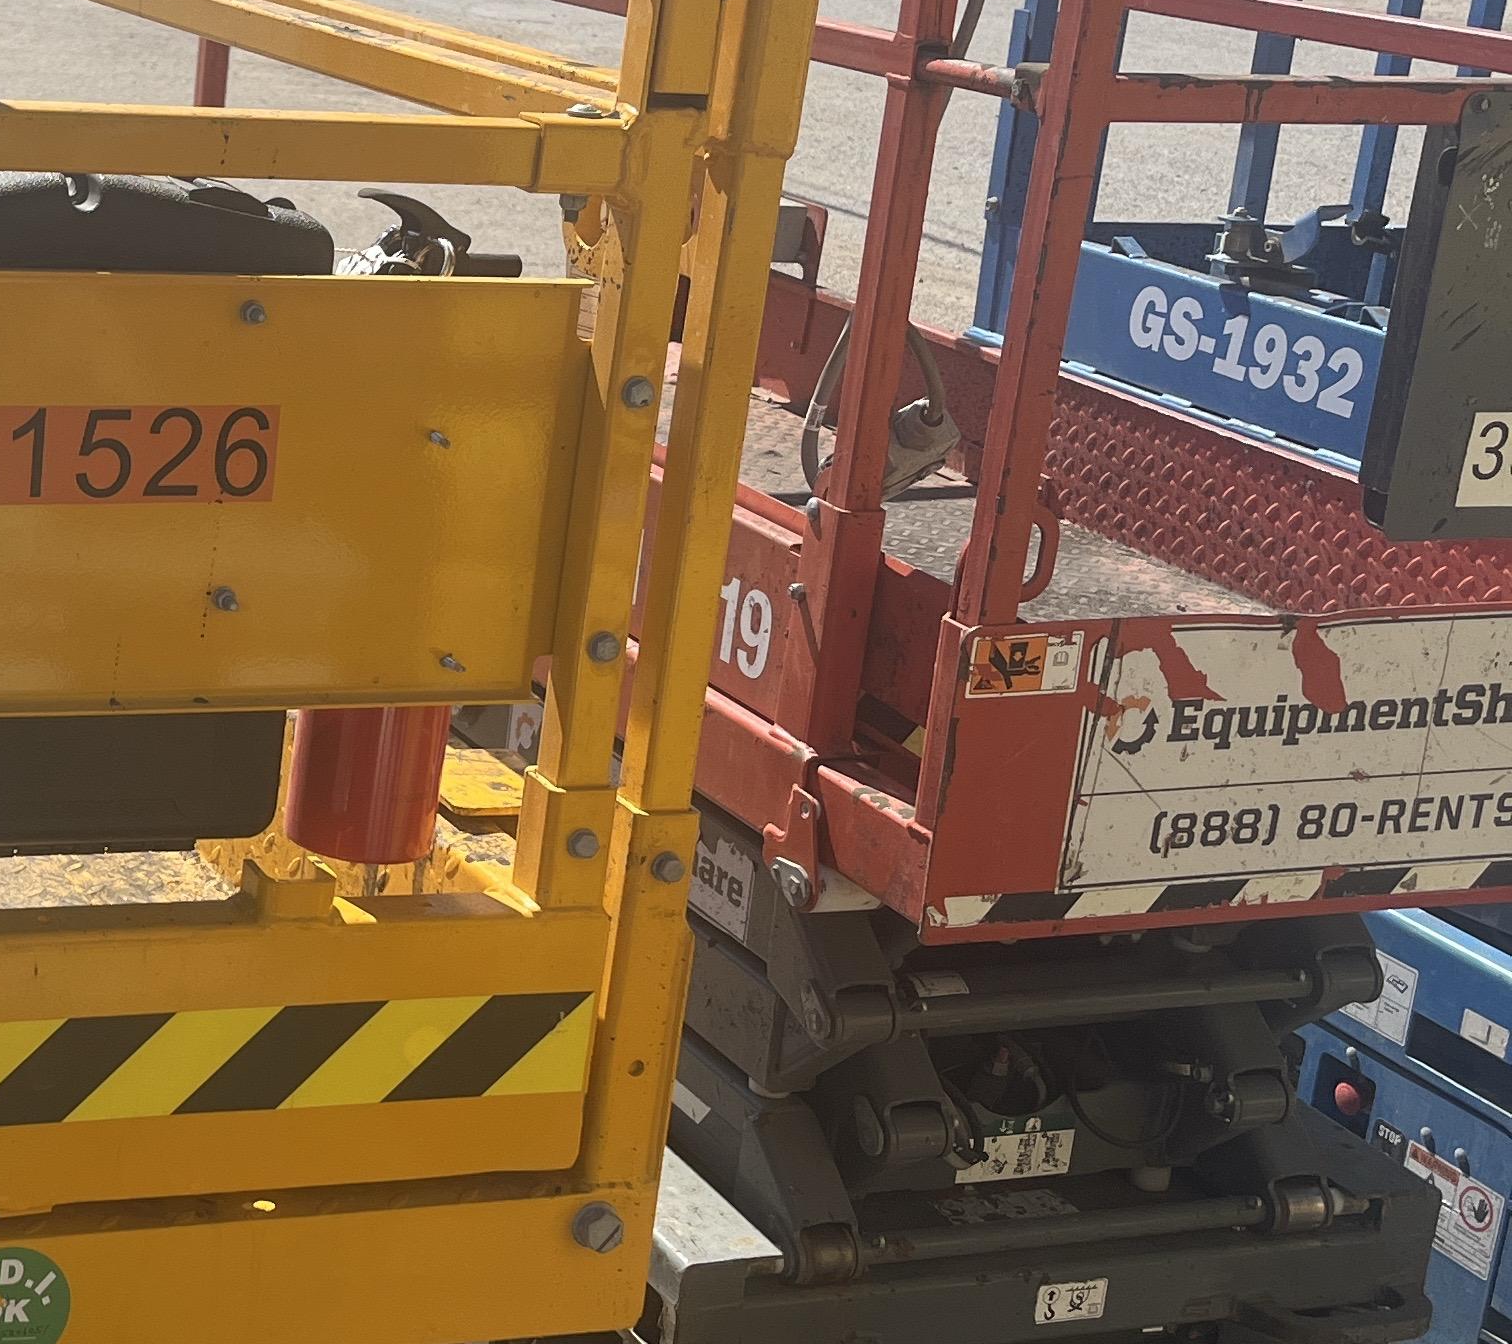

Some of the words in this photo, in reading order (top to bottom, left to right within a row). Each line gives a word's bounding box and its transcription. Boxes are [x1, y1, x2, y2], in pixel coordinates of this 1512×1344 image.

[1129, 285, 1364, 419] GS-1932
[1471, 420, 1512, 481] 3
[1150, 804, 1281, 854] (888)
[1377, 1124, 1402, 1146] STOP
